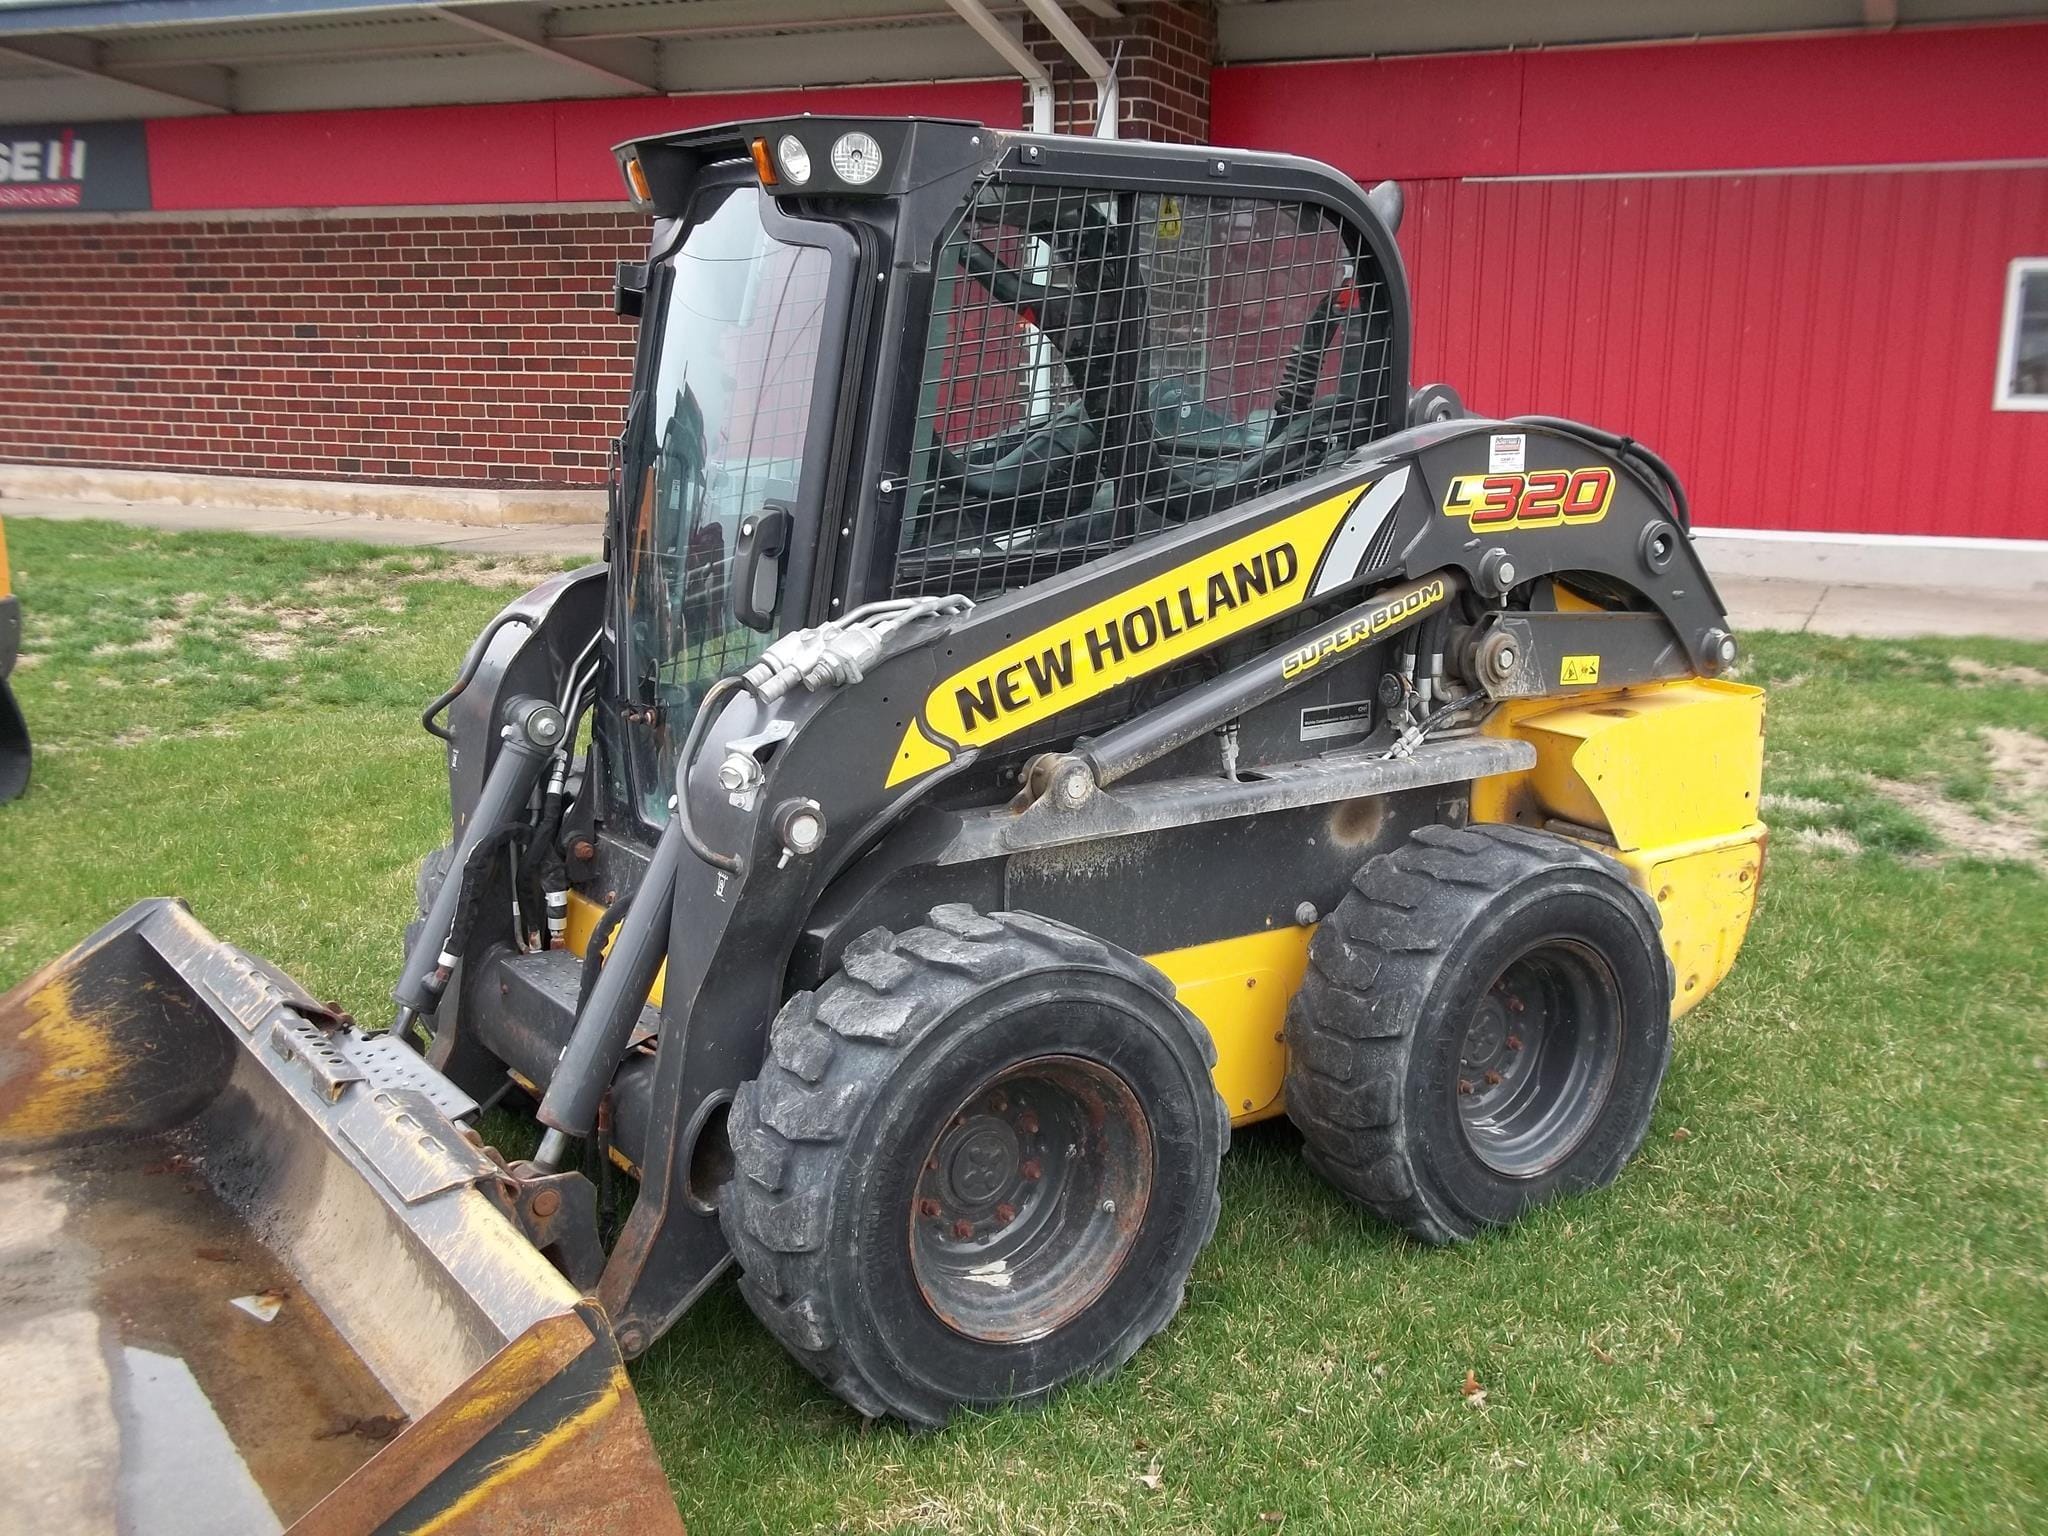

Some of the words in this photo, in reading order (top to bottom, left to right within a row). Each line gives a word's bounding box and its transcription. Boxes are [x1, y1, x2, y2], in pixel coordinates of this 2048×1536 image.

[1445, 468, 1613, 526] L320
[954, 639, 1075, 733] NEW
[1084, 541, 1299, 674] HOLLAND
[1283, 620, 1369, 677] SUPER
[1372, 580, 1443, 632] BOOM
